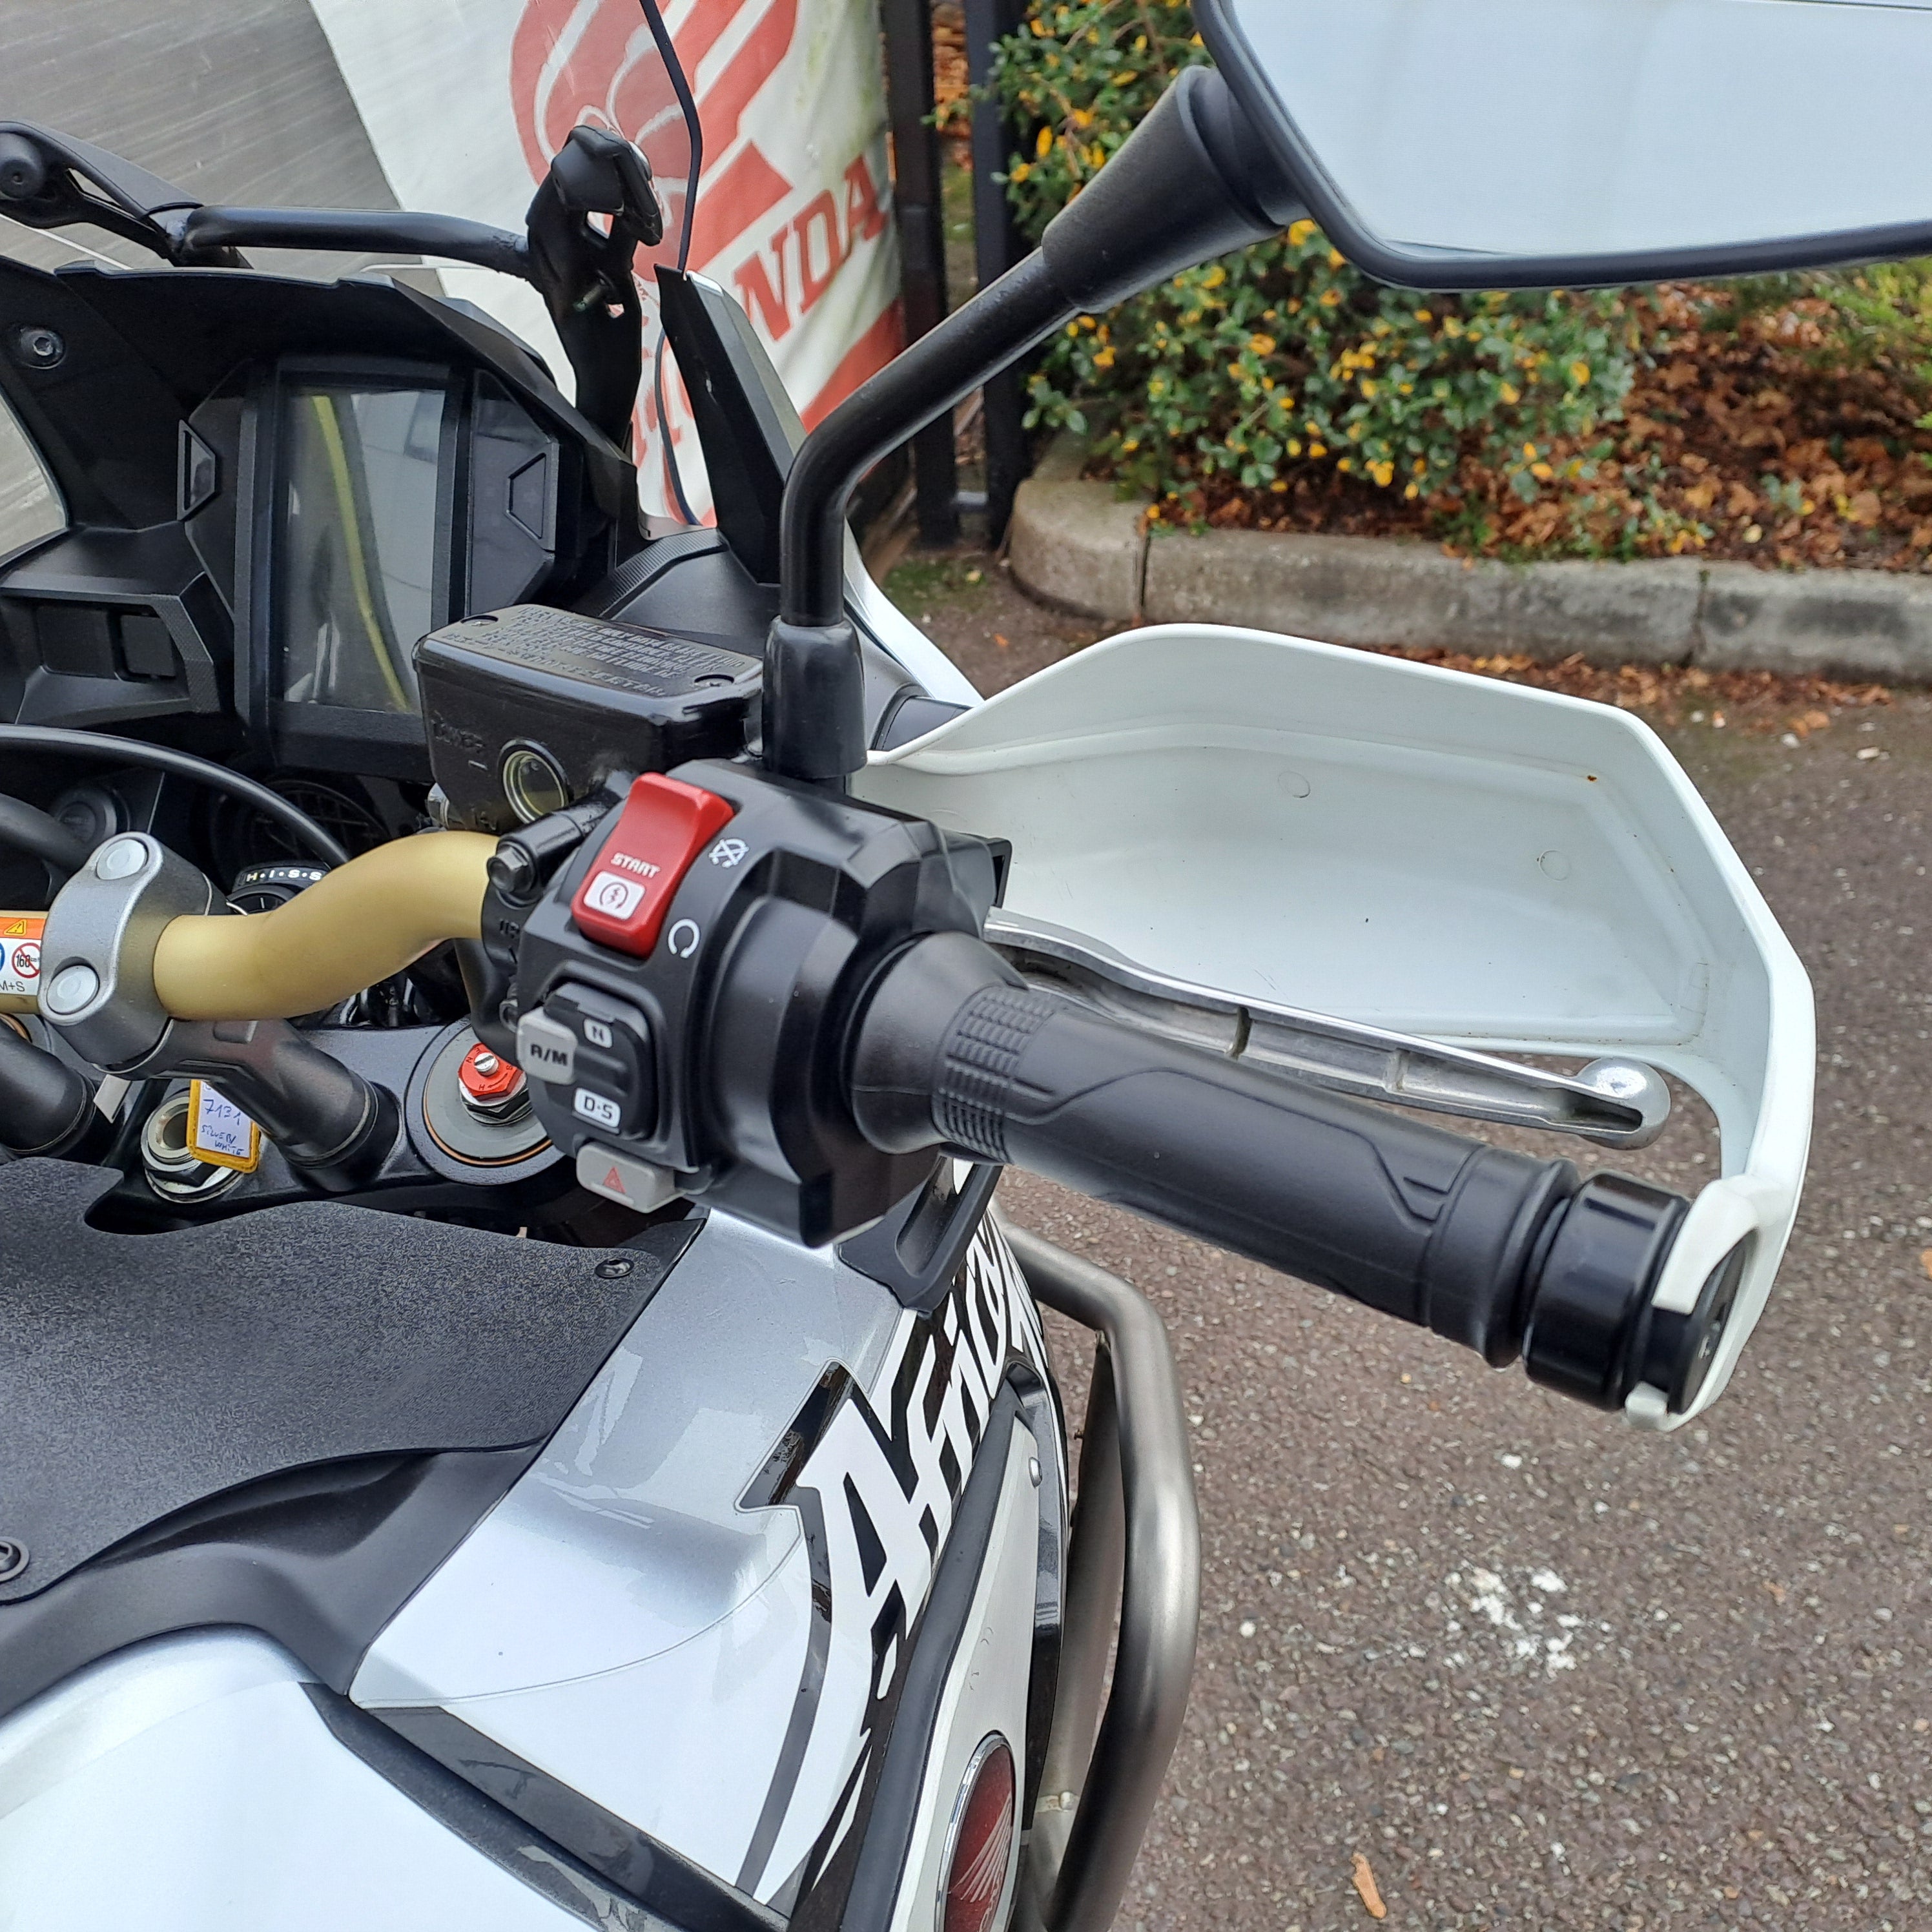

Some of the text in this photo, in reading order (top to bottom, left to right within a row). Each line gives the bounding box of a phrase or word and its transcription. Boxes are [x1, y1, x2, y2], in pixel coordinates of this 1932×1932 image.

[610, 852, 661, 878] START
[591, 1025, 604, 1042] N
[202, 1098, 242, 1126] 7131
